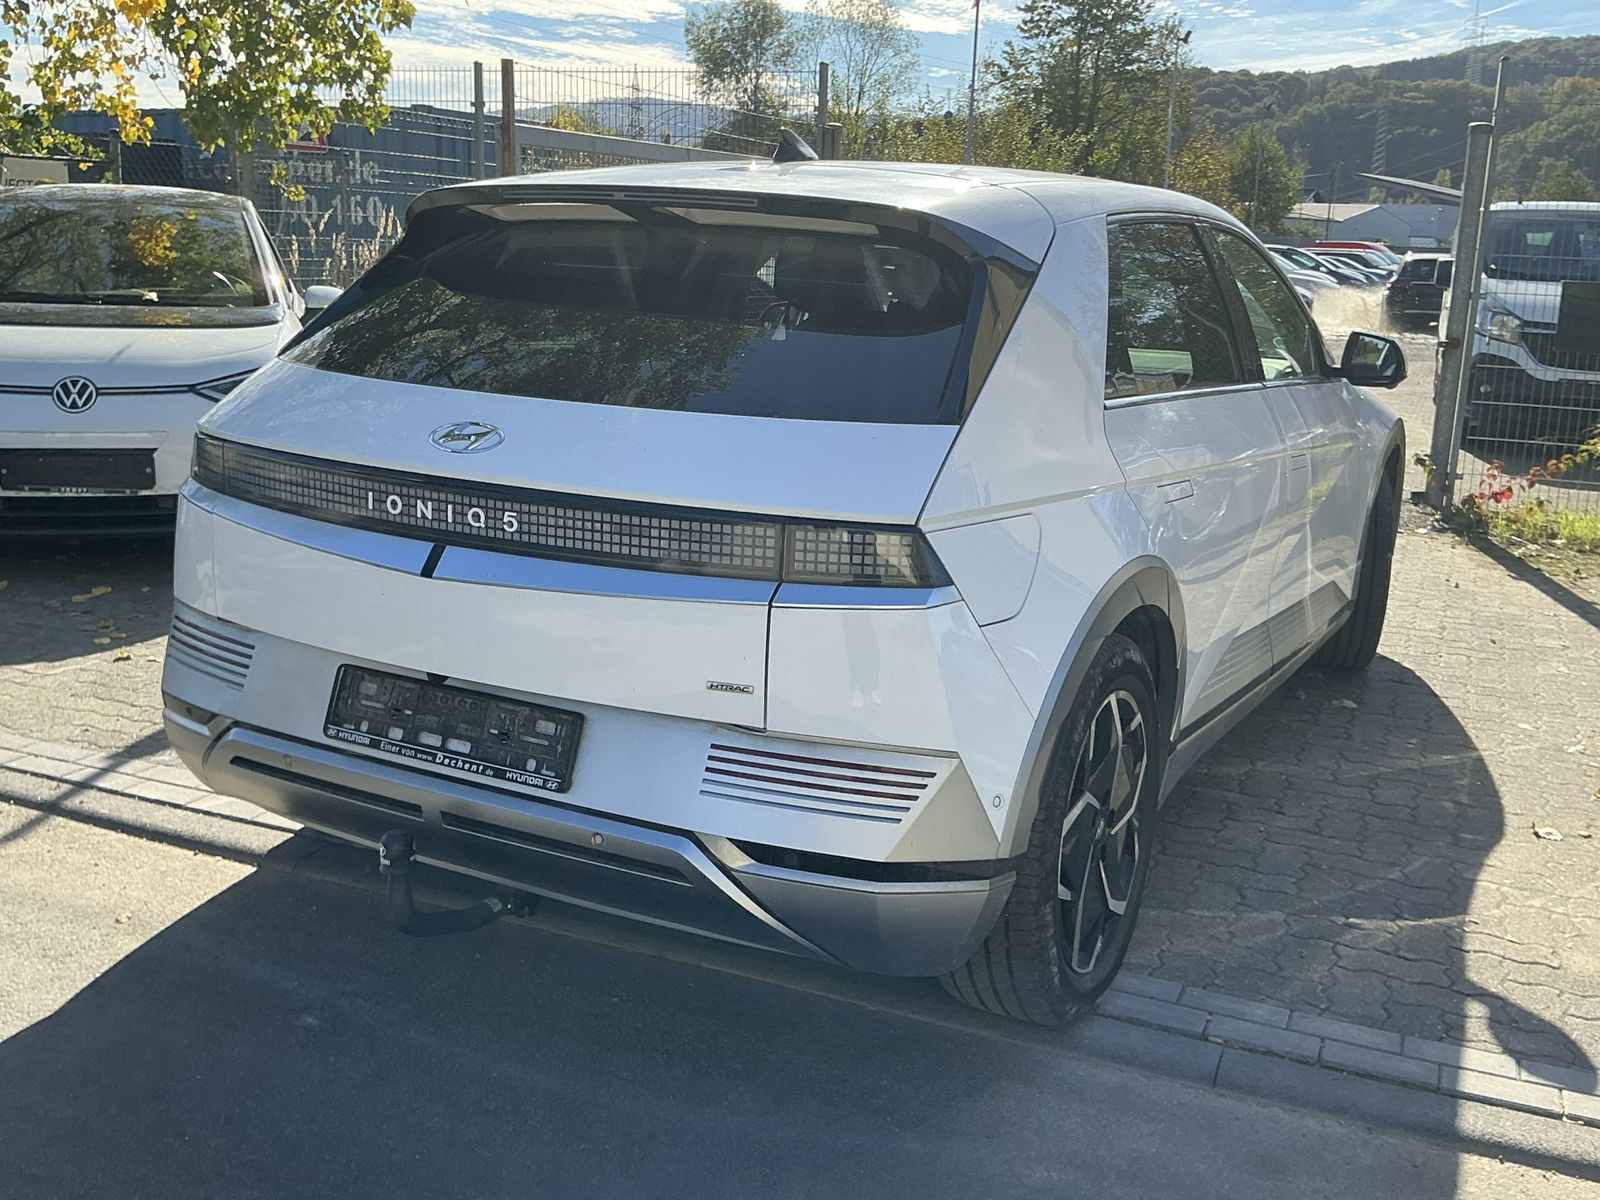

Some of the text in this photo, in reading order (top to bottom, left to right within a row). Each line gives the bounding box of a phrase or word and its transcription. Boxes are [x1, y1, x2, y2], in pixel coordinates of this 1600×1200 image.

[367, 490, 518, 532] IONIQ 5
[709, 683, 750, 694] HTRAC
[338, 730, 370, 745] HYUNDAI
[380, 740, 400, 755] Einer
[401, 747, 416, 758] von
[506, 770, 543, 787] HYUNDAI
